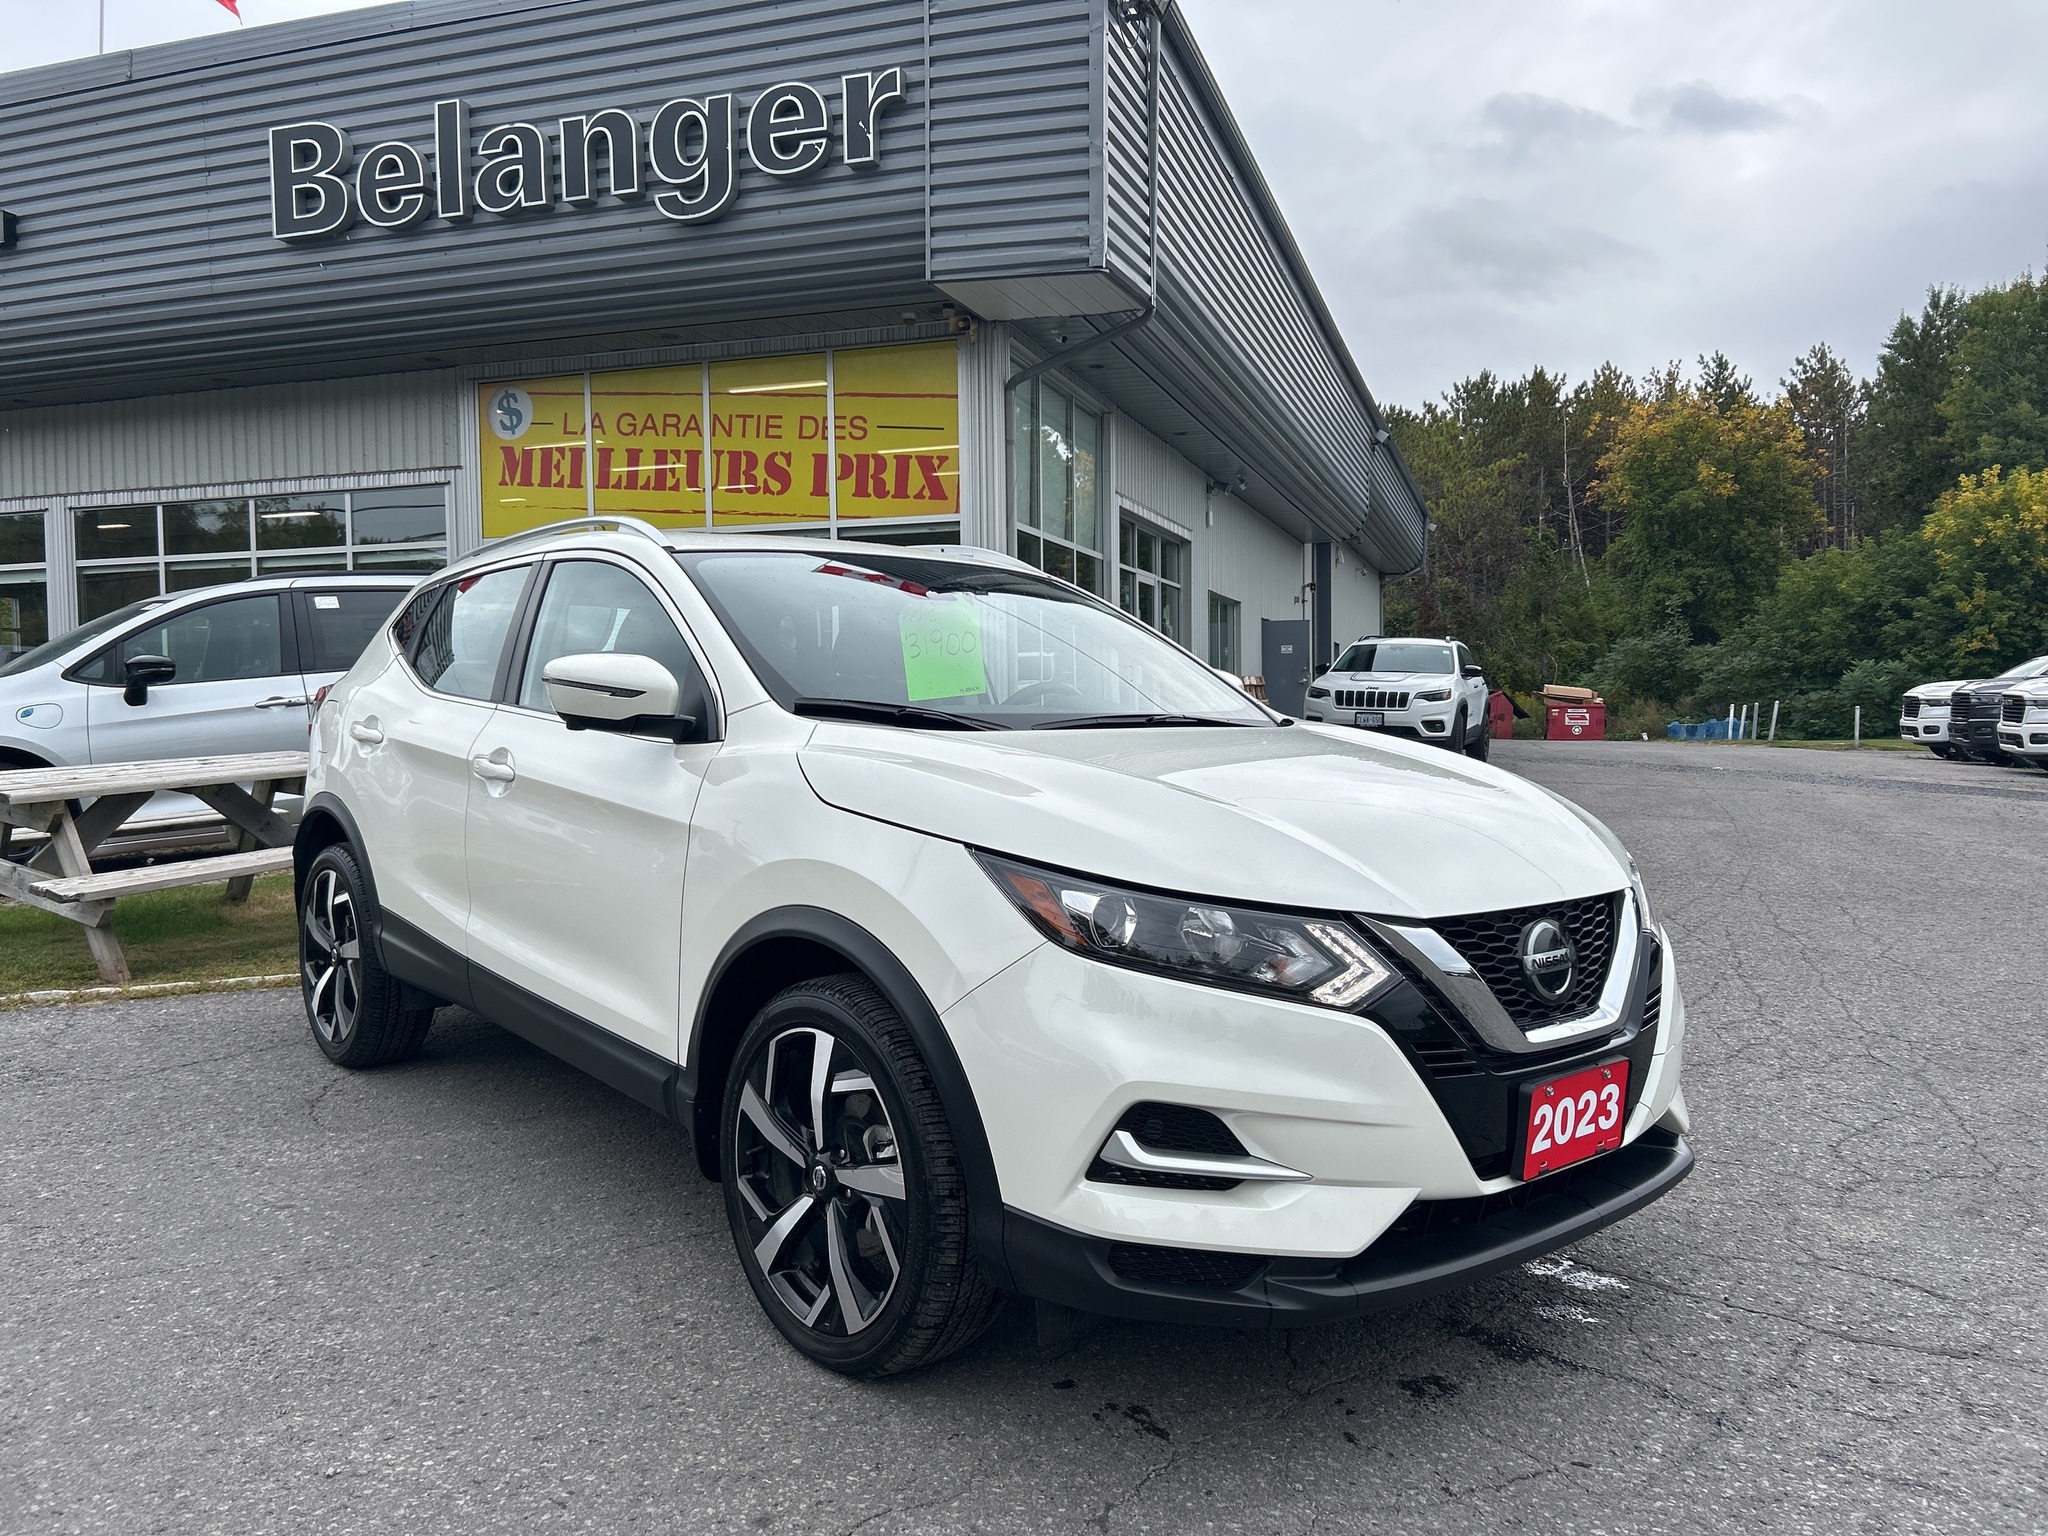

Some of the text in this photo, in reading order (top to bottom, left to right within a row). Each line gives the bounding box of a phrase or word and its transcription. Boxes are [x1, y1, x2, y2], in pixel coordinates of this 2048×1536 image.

[268, 66, 904, 242] Belanger
[562, 412, 868, 440] LA GARANTIE DES
[498, 445, 949, 500] MEILLEURS PRIX
[905, 629, 977, 659] 31900
[1531, 1083, 1620, 1155] 2023
